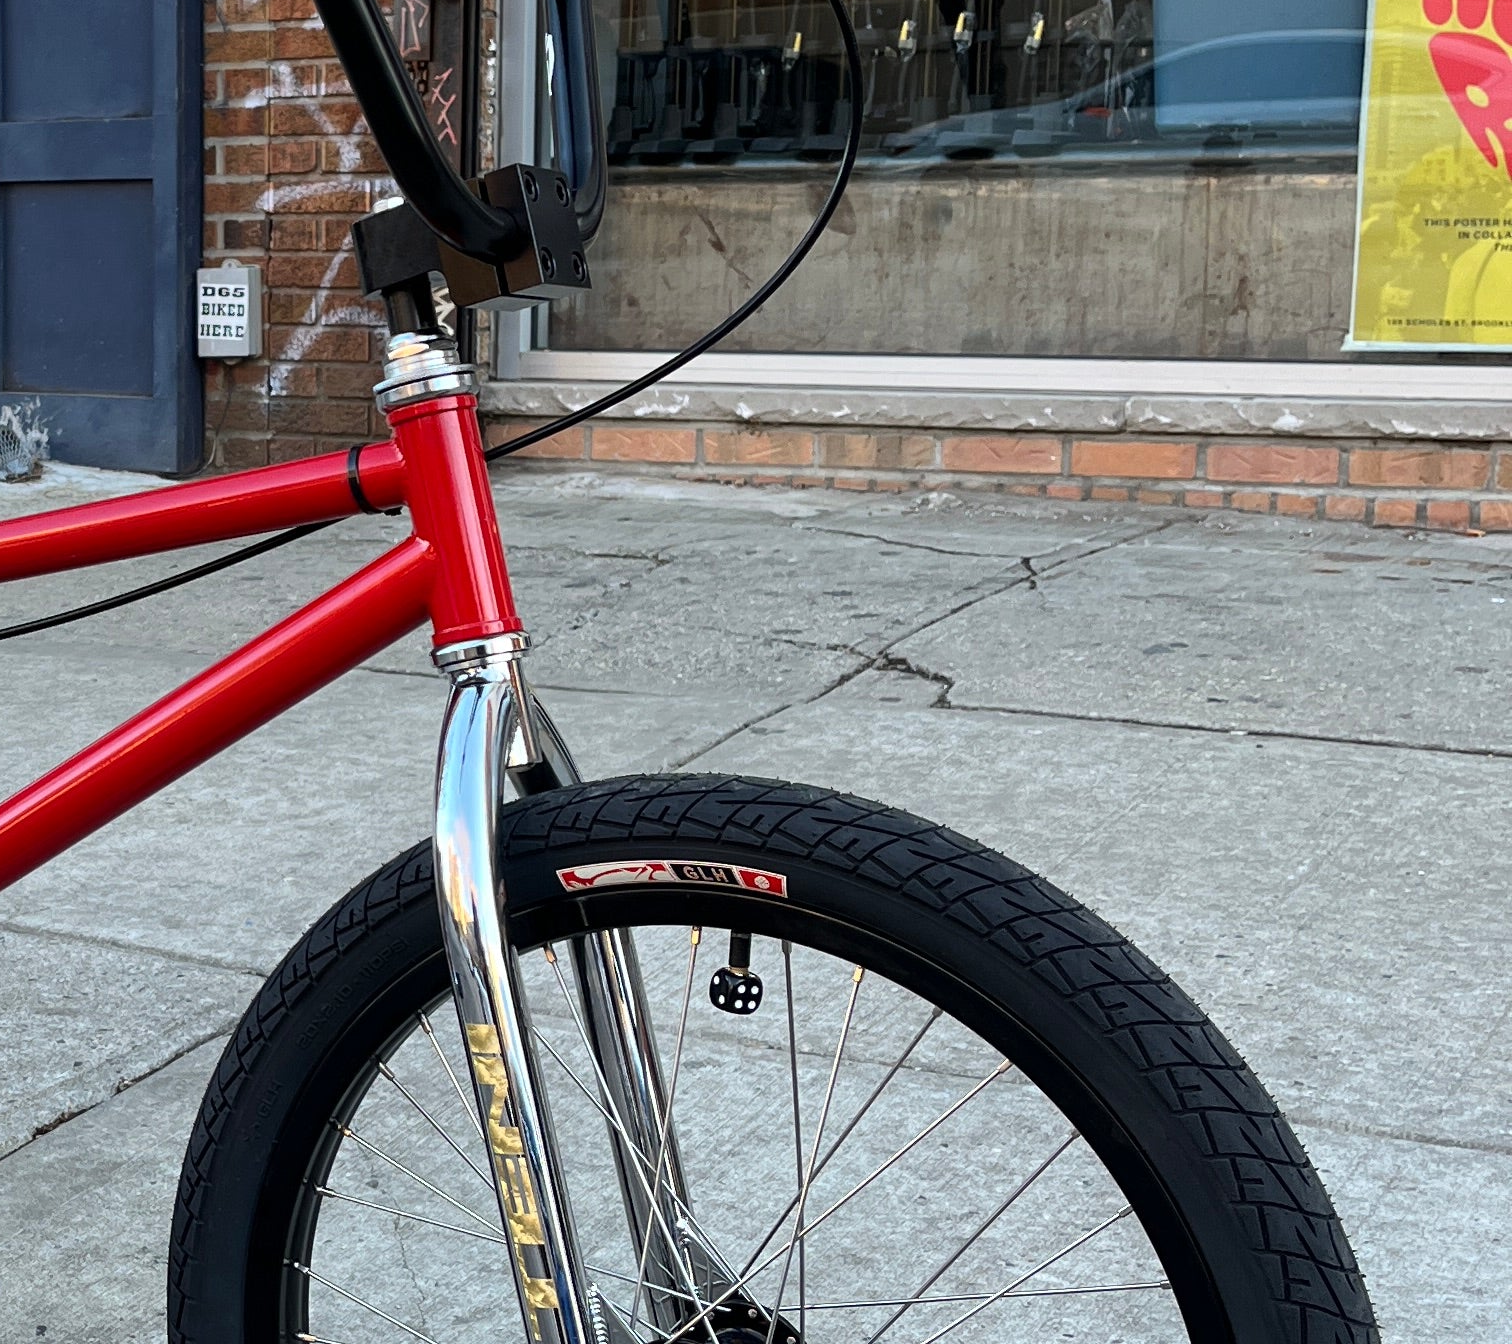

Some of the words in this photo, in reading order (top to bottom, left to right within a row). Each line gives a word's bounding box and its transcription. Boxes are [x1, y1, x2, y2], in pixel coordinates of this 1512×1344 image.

[1453, 218, 1500, 227] POSTER
[201, 303, 245, 316] BIKED
[200, 324, 244, 337] HERE
[682, 865, 729, 883] GLH
